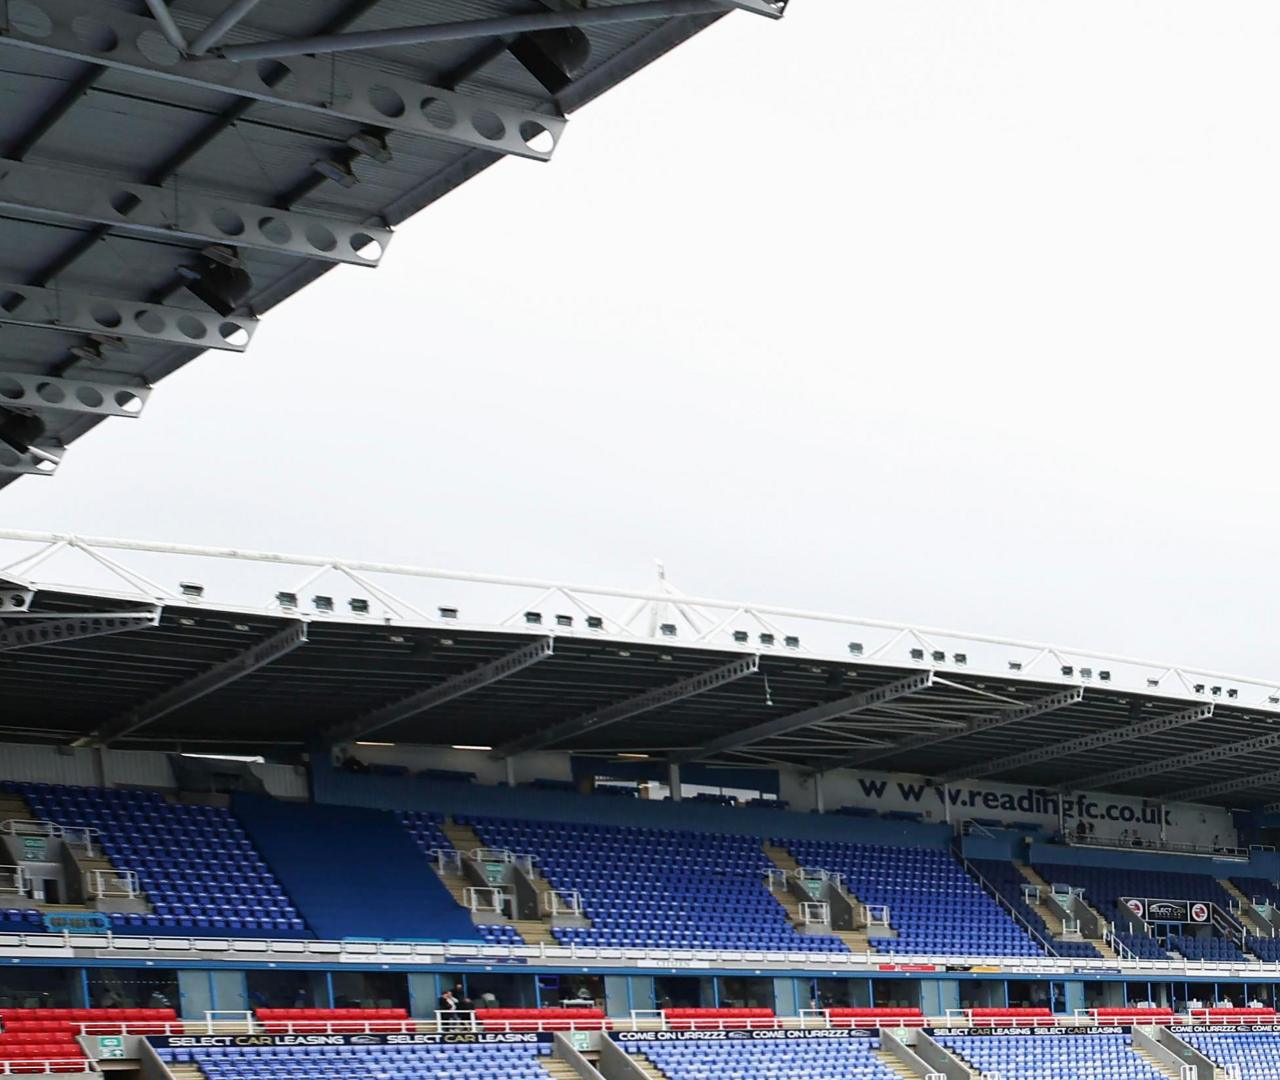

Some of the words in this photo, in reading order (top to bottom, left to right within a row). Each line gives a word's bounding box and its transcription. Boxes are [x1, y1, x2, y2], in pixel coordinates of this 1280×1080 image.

[753, 1030, 787, 1039] COME
[788, 1030, 805, 1039] ON
[934, 1028, 970, 1036] SELECT
[992, 1027, 1030, 1035] LEASING
[1034, 1027, 1067, 1035] SELECT
[1087, 1026, 1122, 1034] LEASING
[168, 1037, 234, 1046] SELECT
[235, 1036, 273, 1045] CAR
[275, 1035, 344, 1045] LEASING
[387, 1035, 443, 1044] SELECT
[444, 1034, 477, 1043] CAR
[478, 1033, 538, 1042] LEASING
[619, 1031, 656, 1041] COME
[657, 1031, 677, 1040] ON
